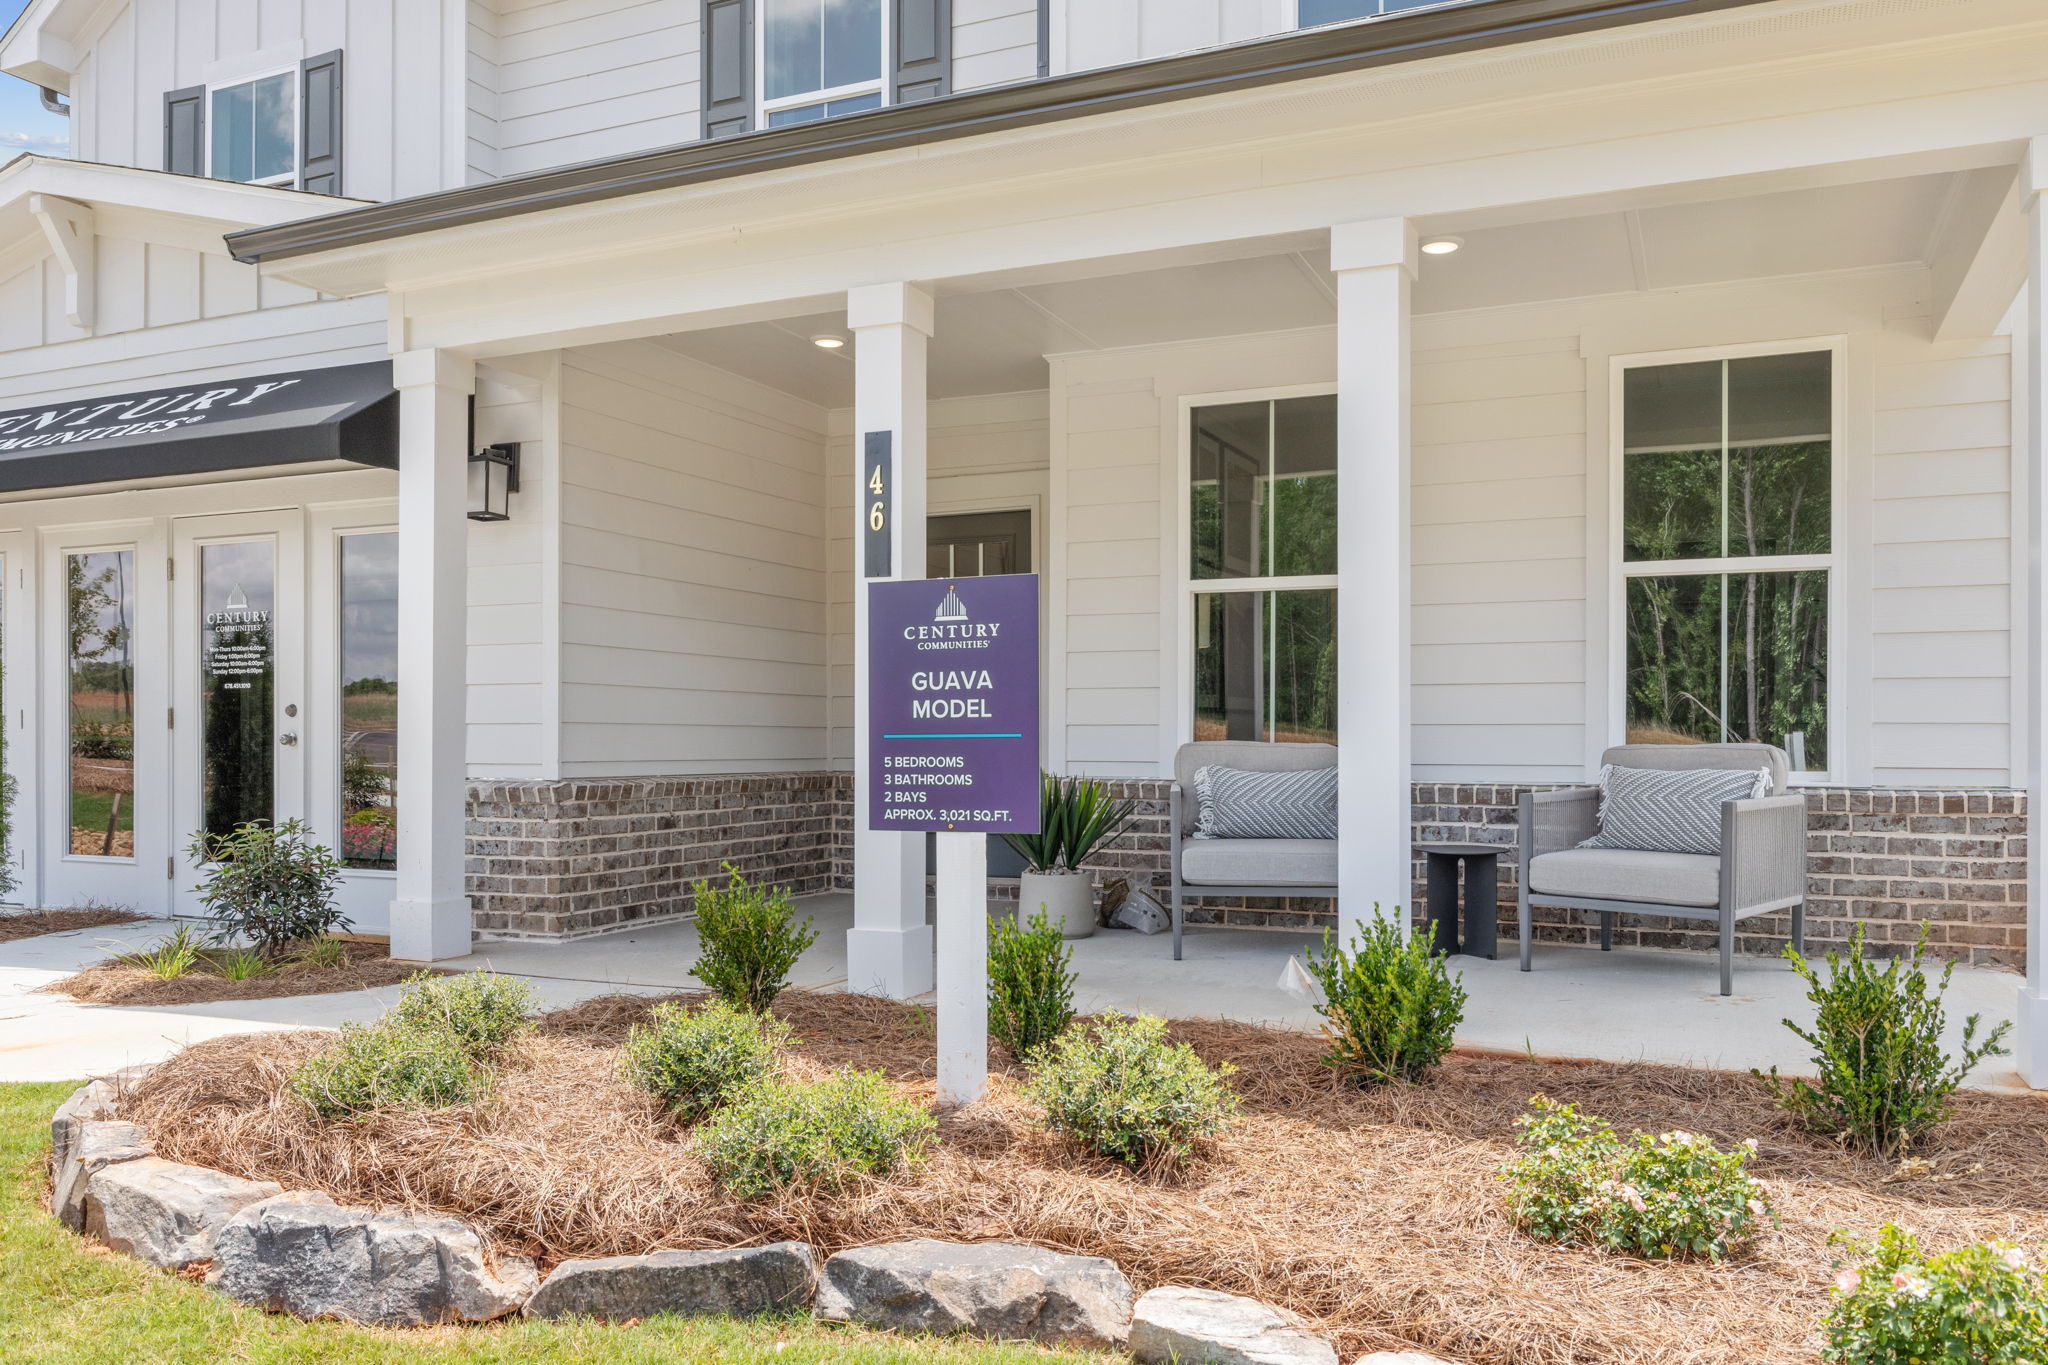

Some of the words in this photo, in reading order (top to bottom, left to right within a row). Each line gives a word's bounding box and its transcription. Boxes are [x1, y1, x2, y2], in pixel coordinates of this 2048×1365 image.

[207, 610, 268, 624] CENTURY
[904, 623, 1000, 640] CENTURY
[911, 670, 993, 691] GUAVA
[912, 699, 992, 719] MODEL
[884, 757, 892, 768] 5
[895, 757, 964, 768] BEDROOMS
[884, 775, 892, 785] 3
[895, 774, 973, 786] BATHROOMS
[884, 792, 892, 803] 2
[895, 791, 927, 803] BAYS
[884, 809, 937, 820] APPROX.
[939, 809, 971, 822] 3,021
[973, 810, 1013, 822] SQ.FT.
